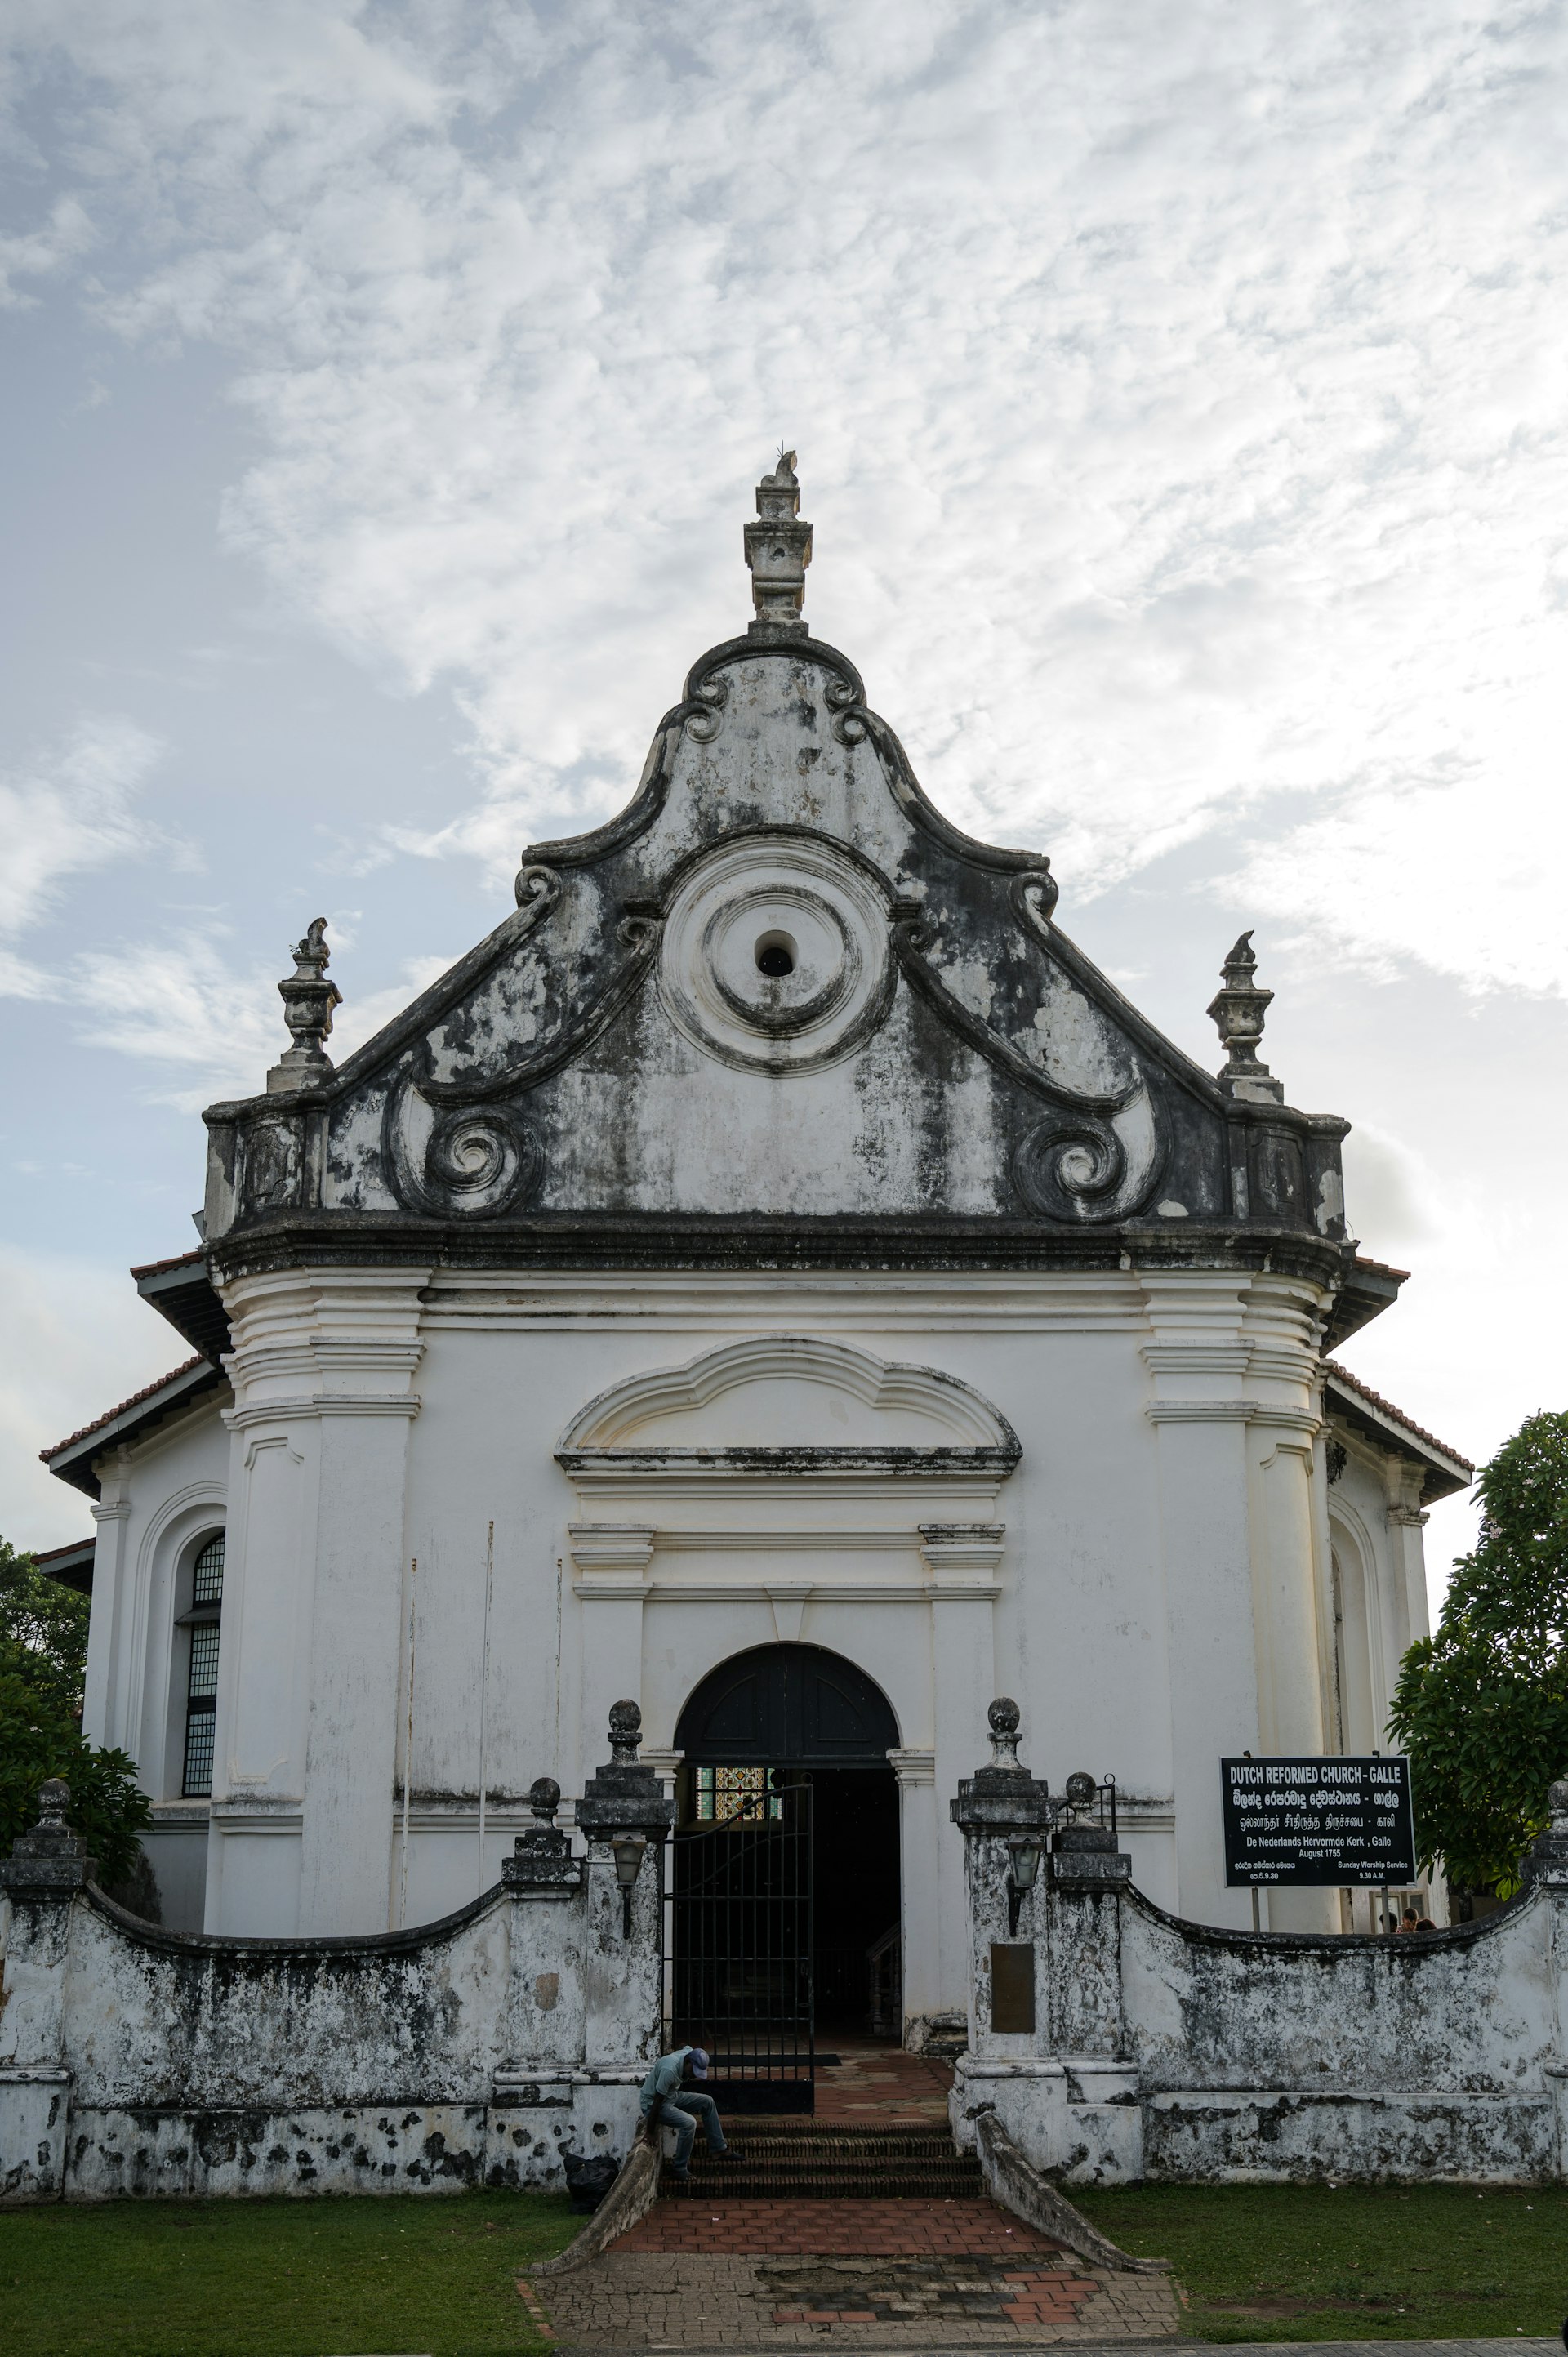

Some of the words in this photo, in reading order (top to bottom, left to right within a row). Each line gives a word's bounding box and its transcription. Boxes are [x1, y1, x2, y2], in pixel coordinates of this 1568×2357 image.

[1230, 1767, 1263, 1784] DUTCH
[1266, 1767, 1318, 1784] REFORMED
[1321, 1767, 1361, 1784] CHURCH
[1370, 1767, 1401, 1784] GALLE
[1309, 1790, 1361, 1809] දේවස්ථානය
[1374, 1790, 1400, 1809] ගාල්ල
[1284, 1813, 1321, 1830] சீர்திருத்த
[1325, 1813, 1364, 1831] திருச்சபை
[1377, 1813, 1396, 1828] காலி
[1246, 1837, 1258, 1847] De
[1258, 1837, 1301, 1847] Nederlands
[1303, 1837, 1345, 1847] Hervormde
[1347, 1837, 1365, 1847] Kerk
[1372, 1836, 1392, 1847] Galle
[1298, 1849, 1323, 1860] August
[1325, 1849, 1341, 1858] 1755
[1338, 1861, 1360, 1869] Sunday
[1361, 1861, 1385, 1869] Worship
